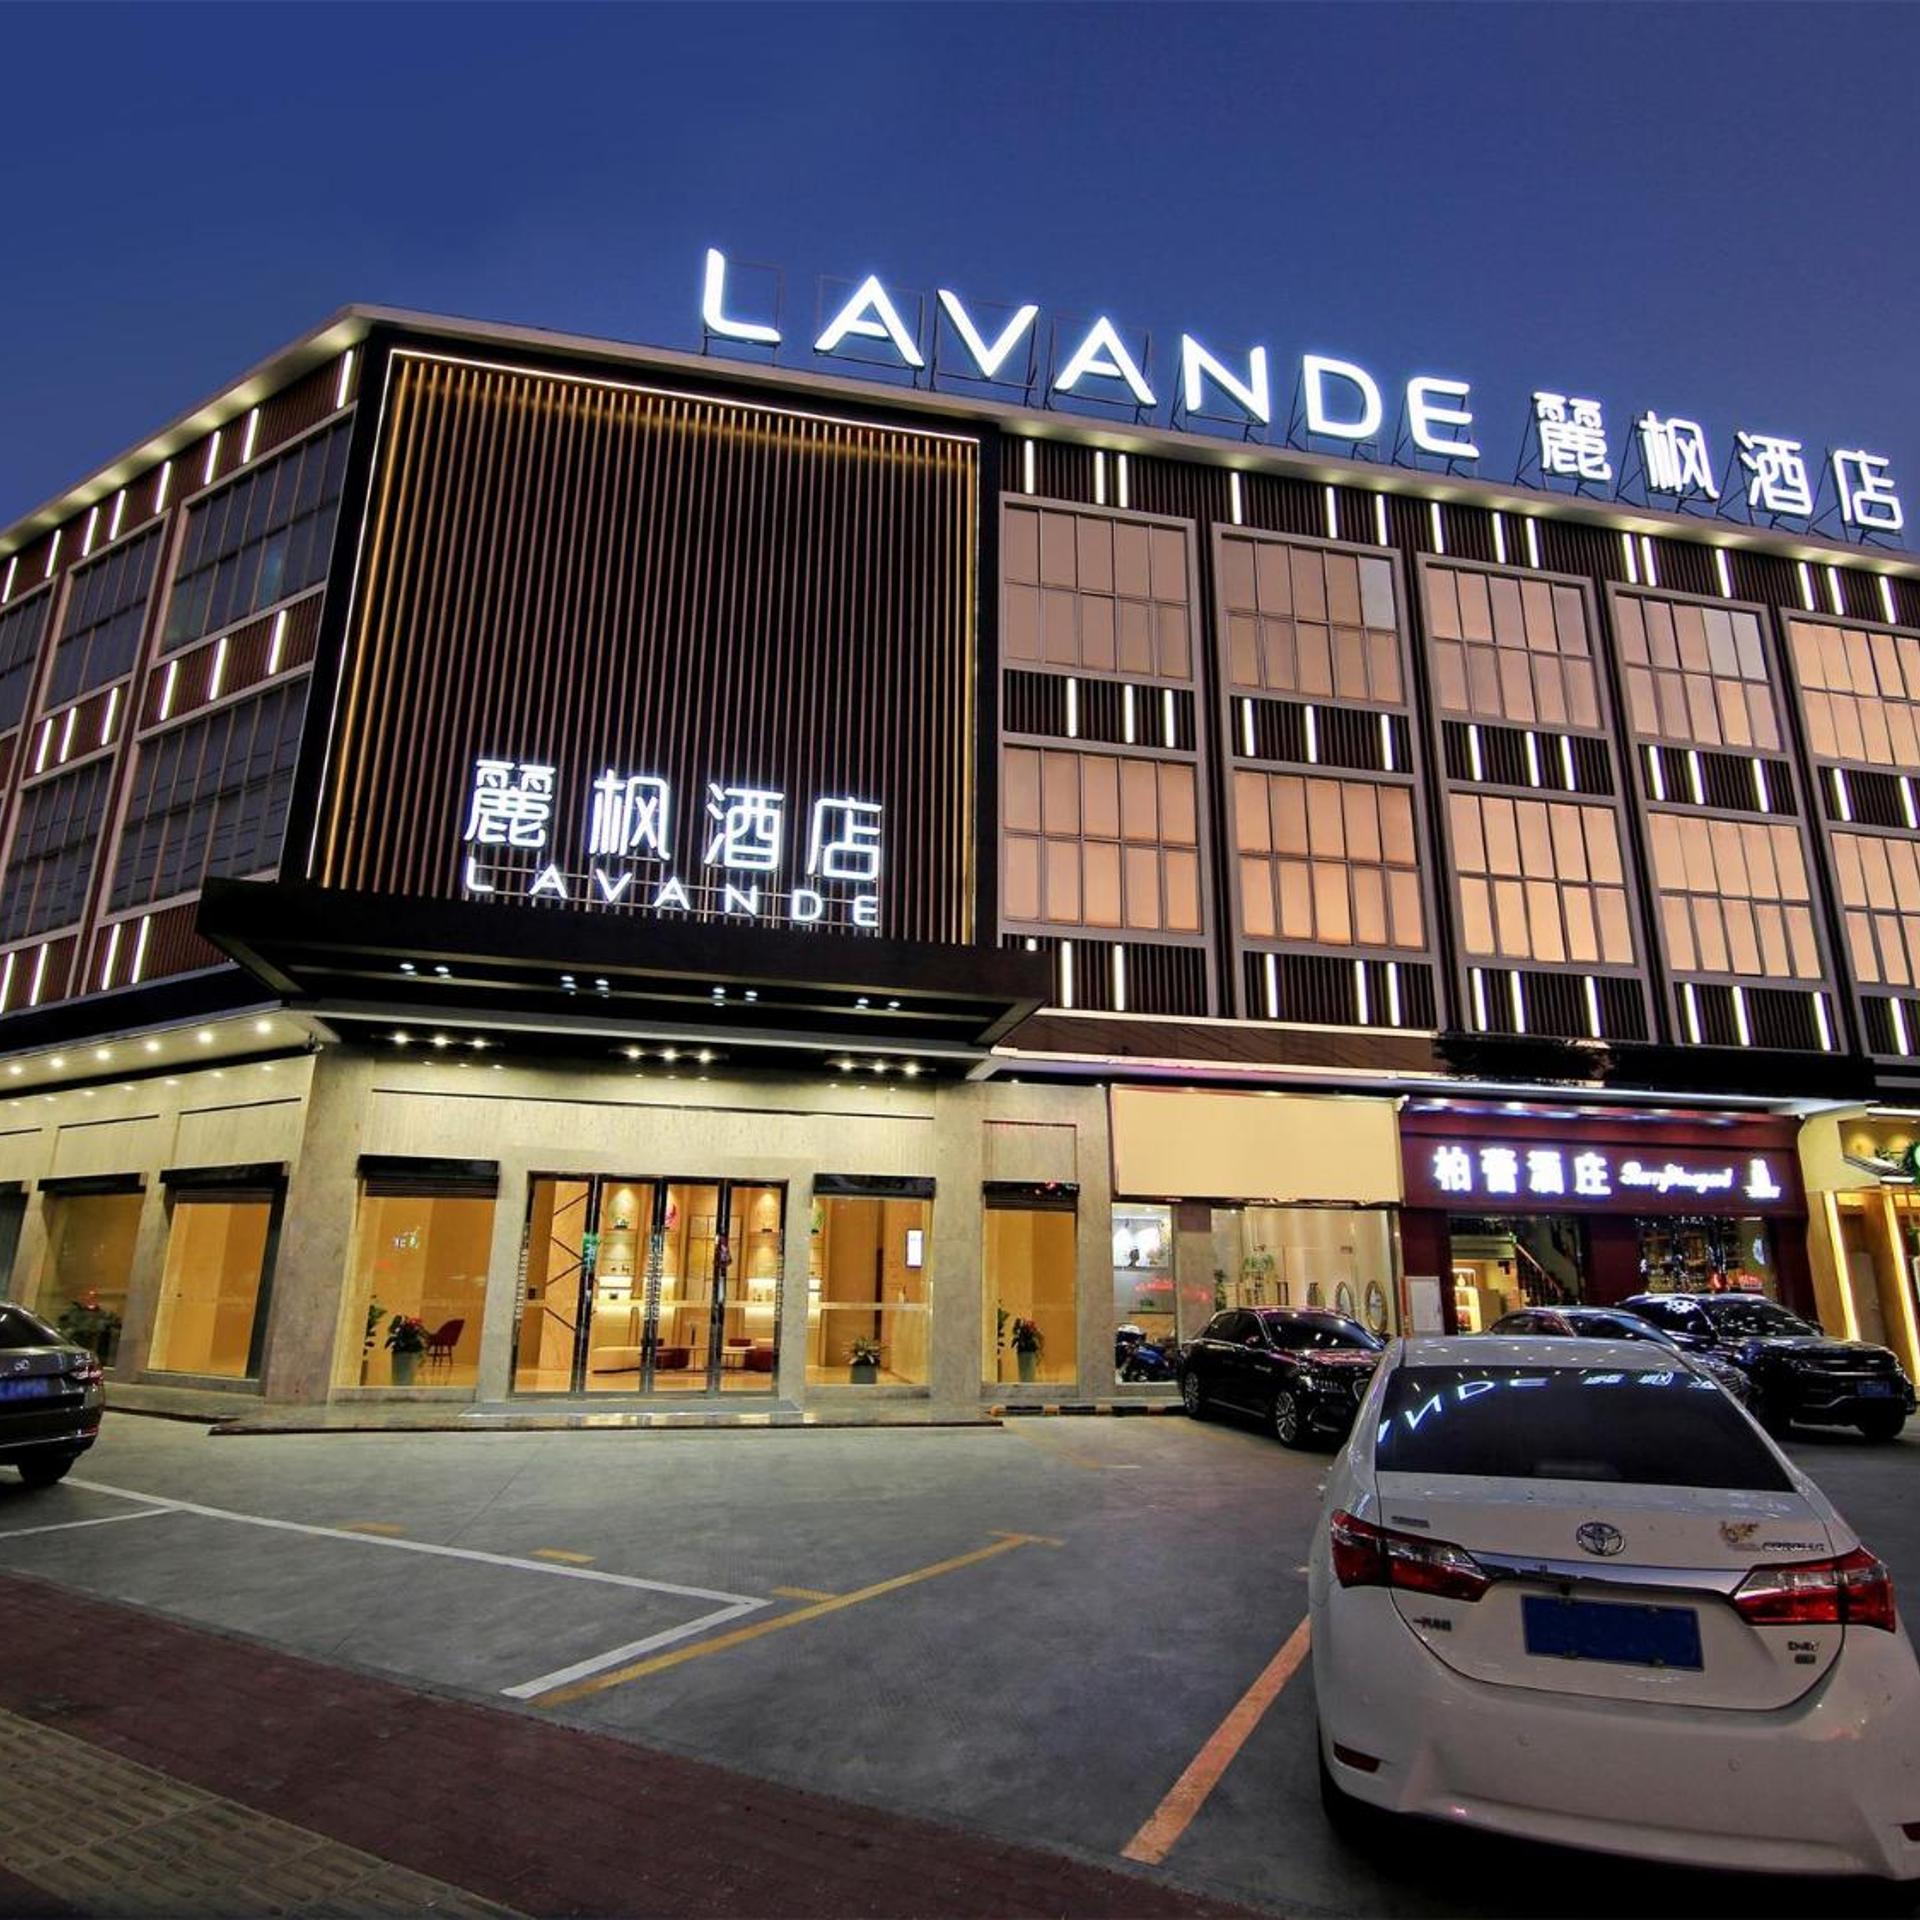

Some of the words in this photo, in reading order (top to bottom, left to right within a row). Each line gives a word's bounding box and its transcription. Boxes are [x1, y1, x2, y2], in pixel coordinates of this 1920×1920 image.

[702, 247, 1480, 460] LAVANDE
[1532, 391, 1904, 531] 麗枫酒店
[463, 758, 883, 881] 麗枫酒店
[465, 856, 880, 929] LAVANDE
